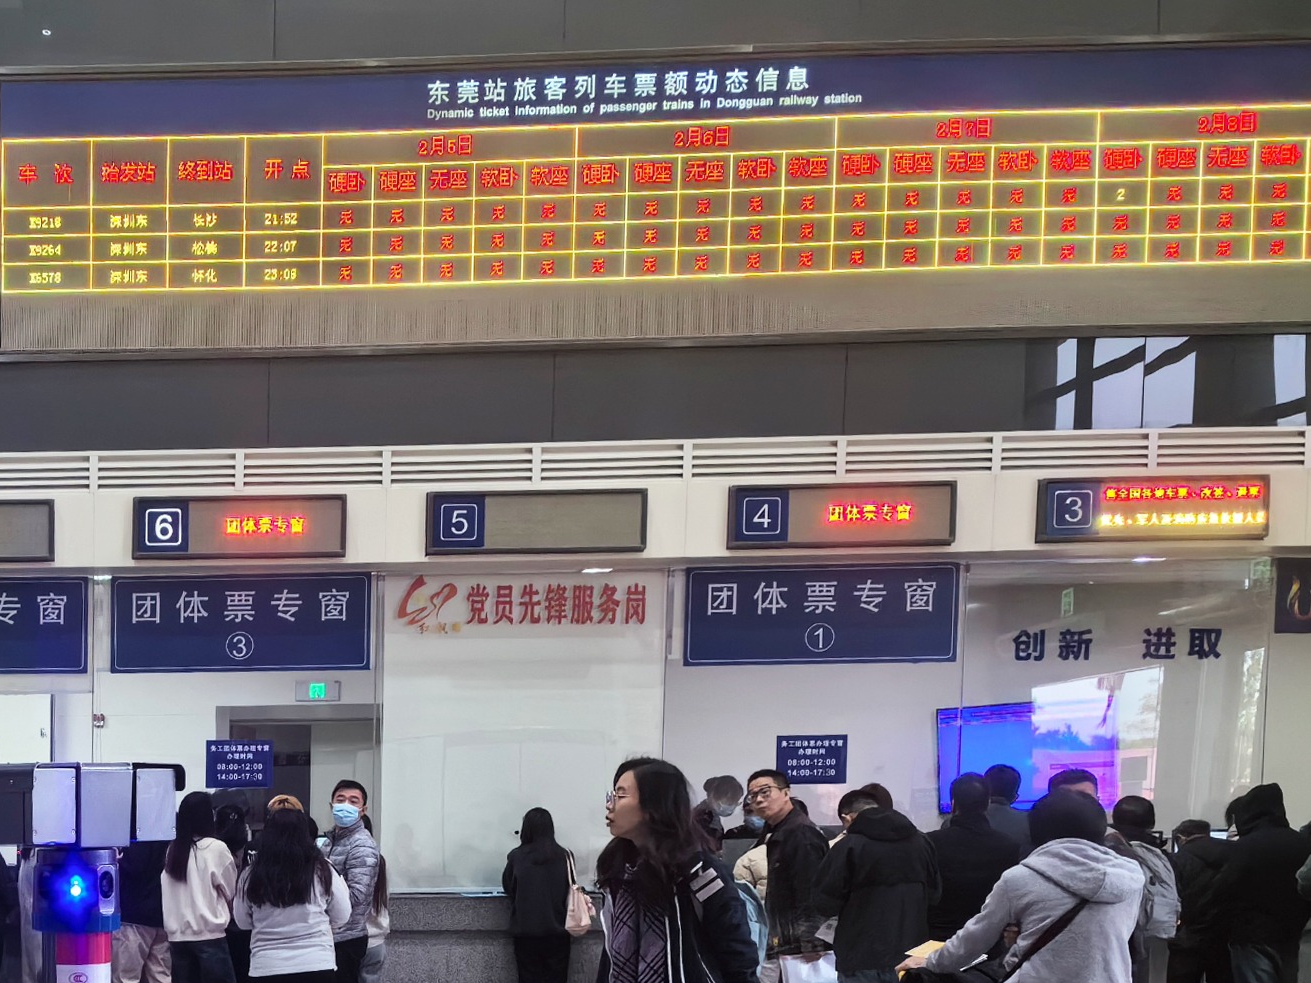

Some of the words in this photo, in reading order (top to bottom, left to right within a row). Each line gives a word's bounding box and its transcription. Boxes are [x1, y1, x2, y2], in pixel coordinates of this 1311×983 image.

[427, 66, 810, 106] 东莞站旅客列车票额动态信息
[427, 106, 475, 121] Dynamic
[480, 105, 510, 118] ticket
[515, 103, 578, 117] information
[583, 102, 596, 115] of
[600, 101, 658, 117] passenger
[663, 99, 695, 112] trains
[700, 98, 712, 110] in
[717, 96, 774, 111] Dongguan
[779, 94, 820, 108] railway
[825, 92, 863, 105] station
[418, 134, 473, 157] 2月5日
[674, 125, 731, 148] 2月6日
[101, 161, 156, 183] 始发站
[178, 159, 233, 182] 终到站
[264, 158, 311, 180] 开点
[379, 170, 417, 192] 硬座
[430, 168, 468, 190] 无座
[263, 212, 298, 226] 21:52
[263, 240, 298, 253] 22:07
[450, 510, 468, 535] 5
[752, 503, 772, 528] 4
[827, 503, 913, 523] 团体票专窗
[1064, 496, 1084, 522] 3
[154, 514, 174, 541] 6
[225, 515, 306, 536] 团体票专窗
[130, 588, 351, 625] 团体票专窗
[466, 582, 647, 626] 党员先锋服务岗
[706, 578, 938, 616] 团体票专窗
[1012, 628, 1093, 662] 创新
[1142, 626, 1223, 662] 进取
